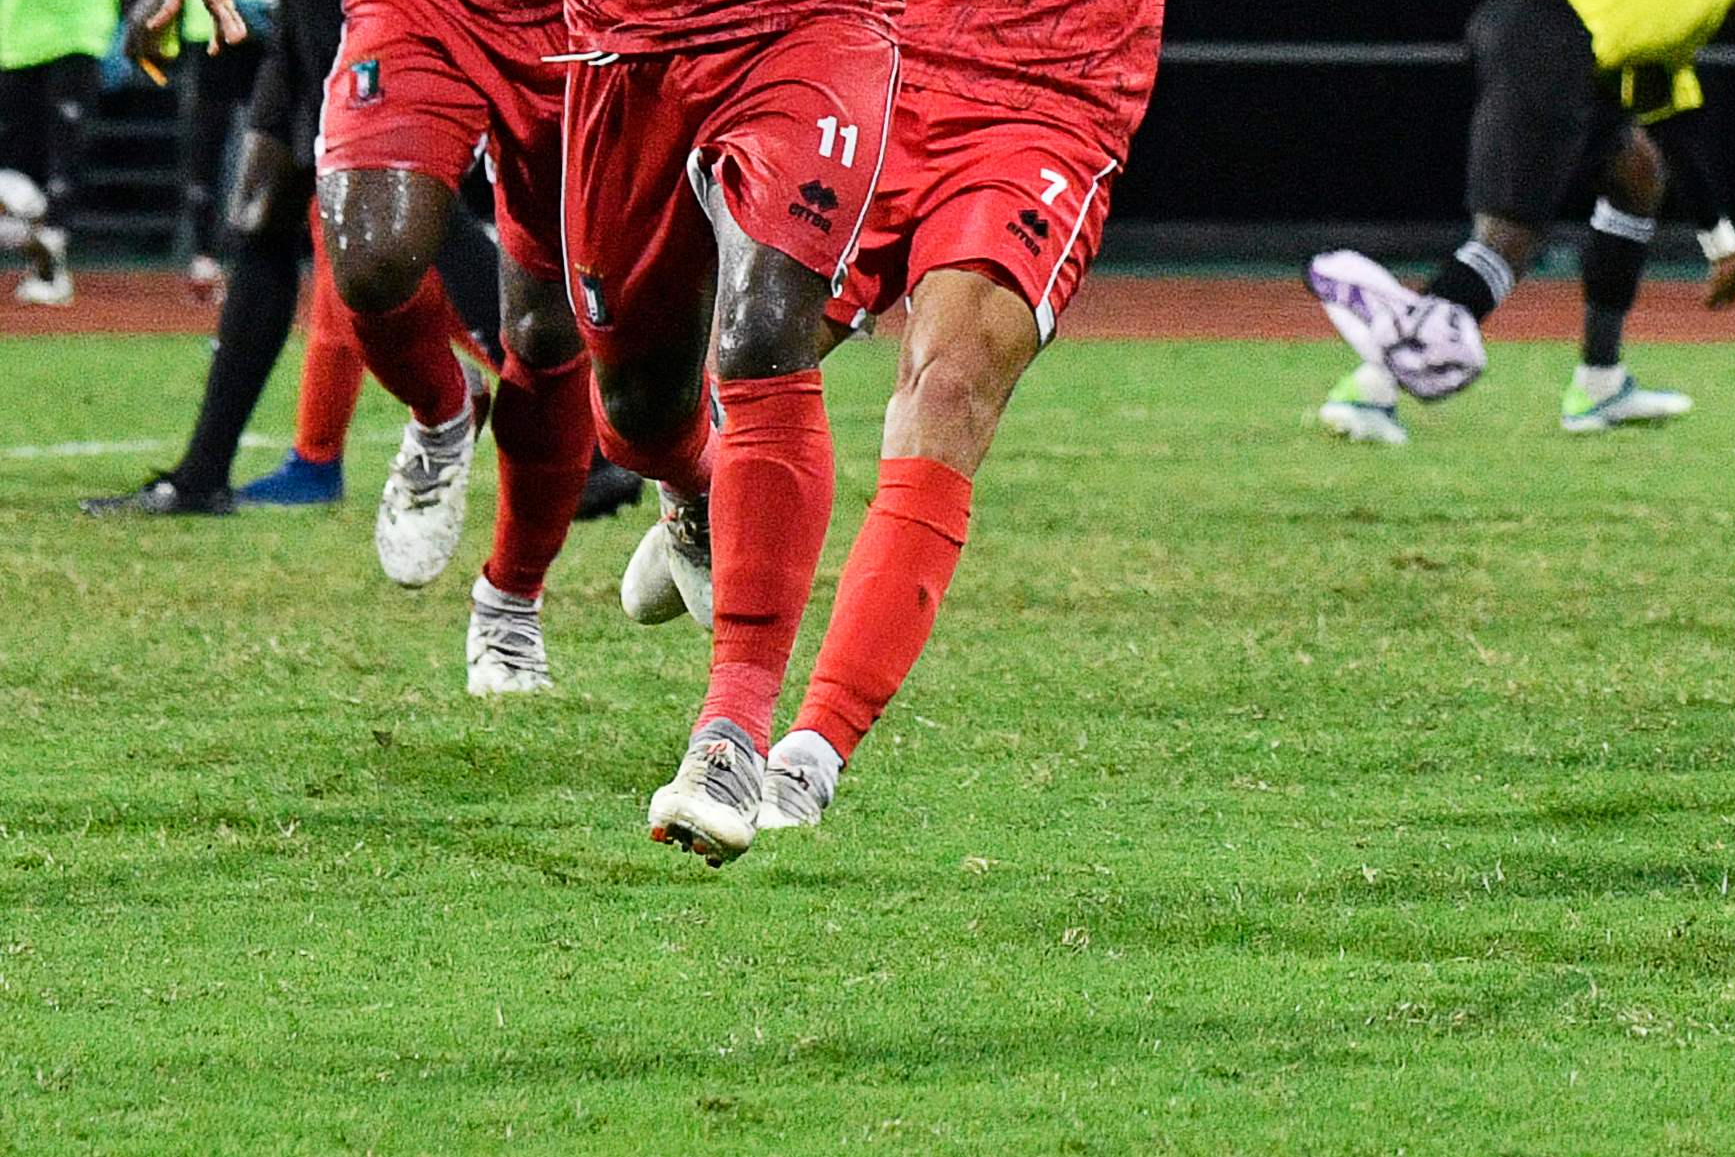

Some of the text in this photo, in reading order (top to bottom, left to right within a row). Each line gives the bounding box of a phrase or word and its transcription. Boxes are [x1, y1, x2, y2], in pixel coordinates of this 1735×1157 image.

[816, 115, 859, 169] 11
[1040, 168, 1068, 206] 7
[788, 203, 833, 235] errea
[1006, 221, 1041, 257] errea
